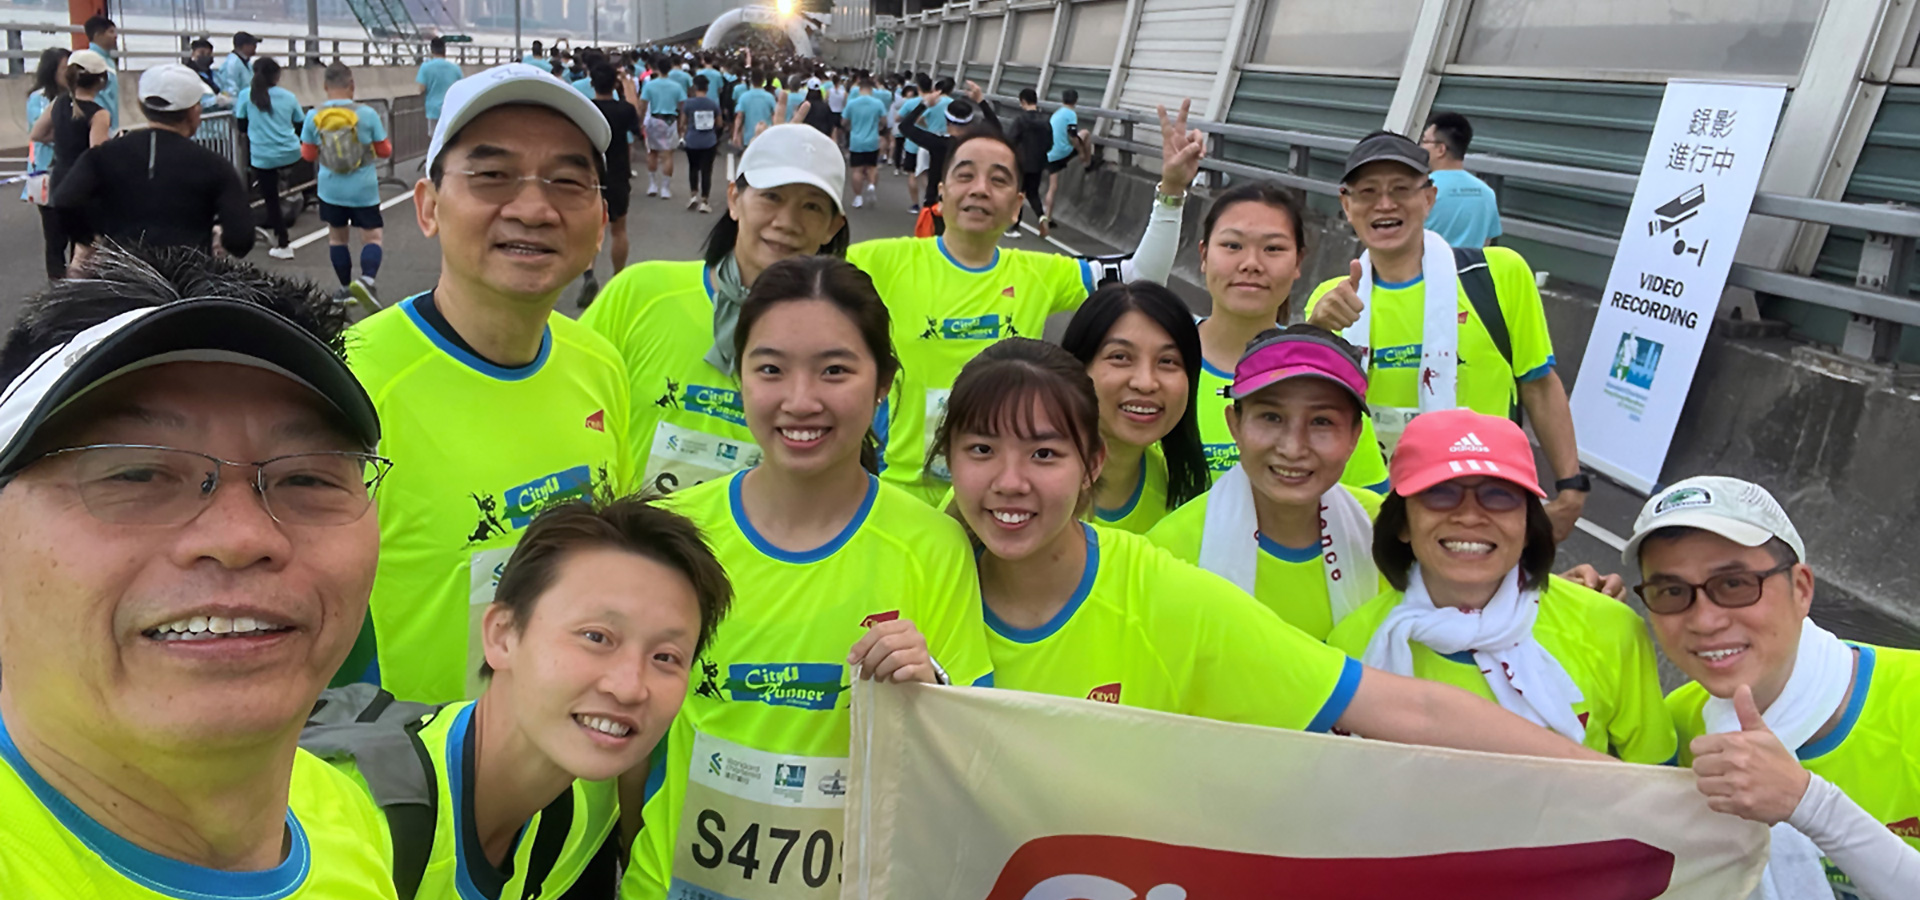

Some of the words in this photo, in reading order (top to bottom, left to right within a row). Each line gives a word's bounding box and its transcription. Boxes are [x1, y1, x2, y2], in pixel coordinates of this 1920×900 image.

[1687, 108, 1737, 138] 錄影
[1665, 142, 1735, 176] 進行中
[1640, 272, 1684, 298] VIDEO
[1610, 291, 1698, 329] RECORDING
[696, 389, 735, 405] CityU
[1449, 445, 1490, 453] adidas
[518, 476, 560, 513] CityU
[745, 666, 799, 690] CityU
[758, 682, 825, 702] Runner
[1090, 690, 1118, 703] CityU
[691, 808, 844, 889] S470
